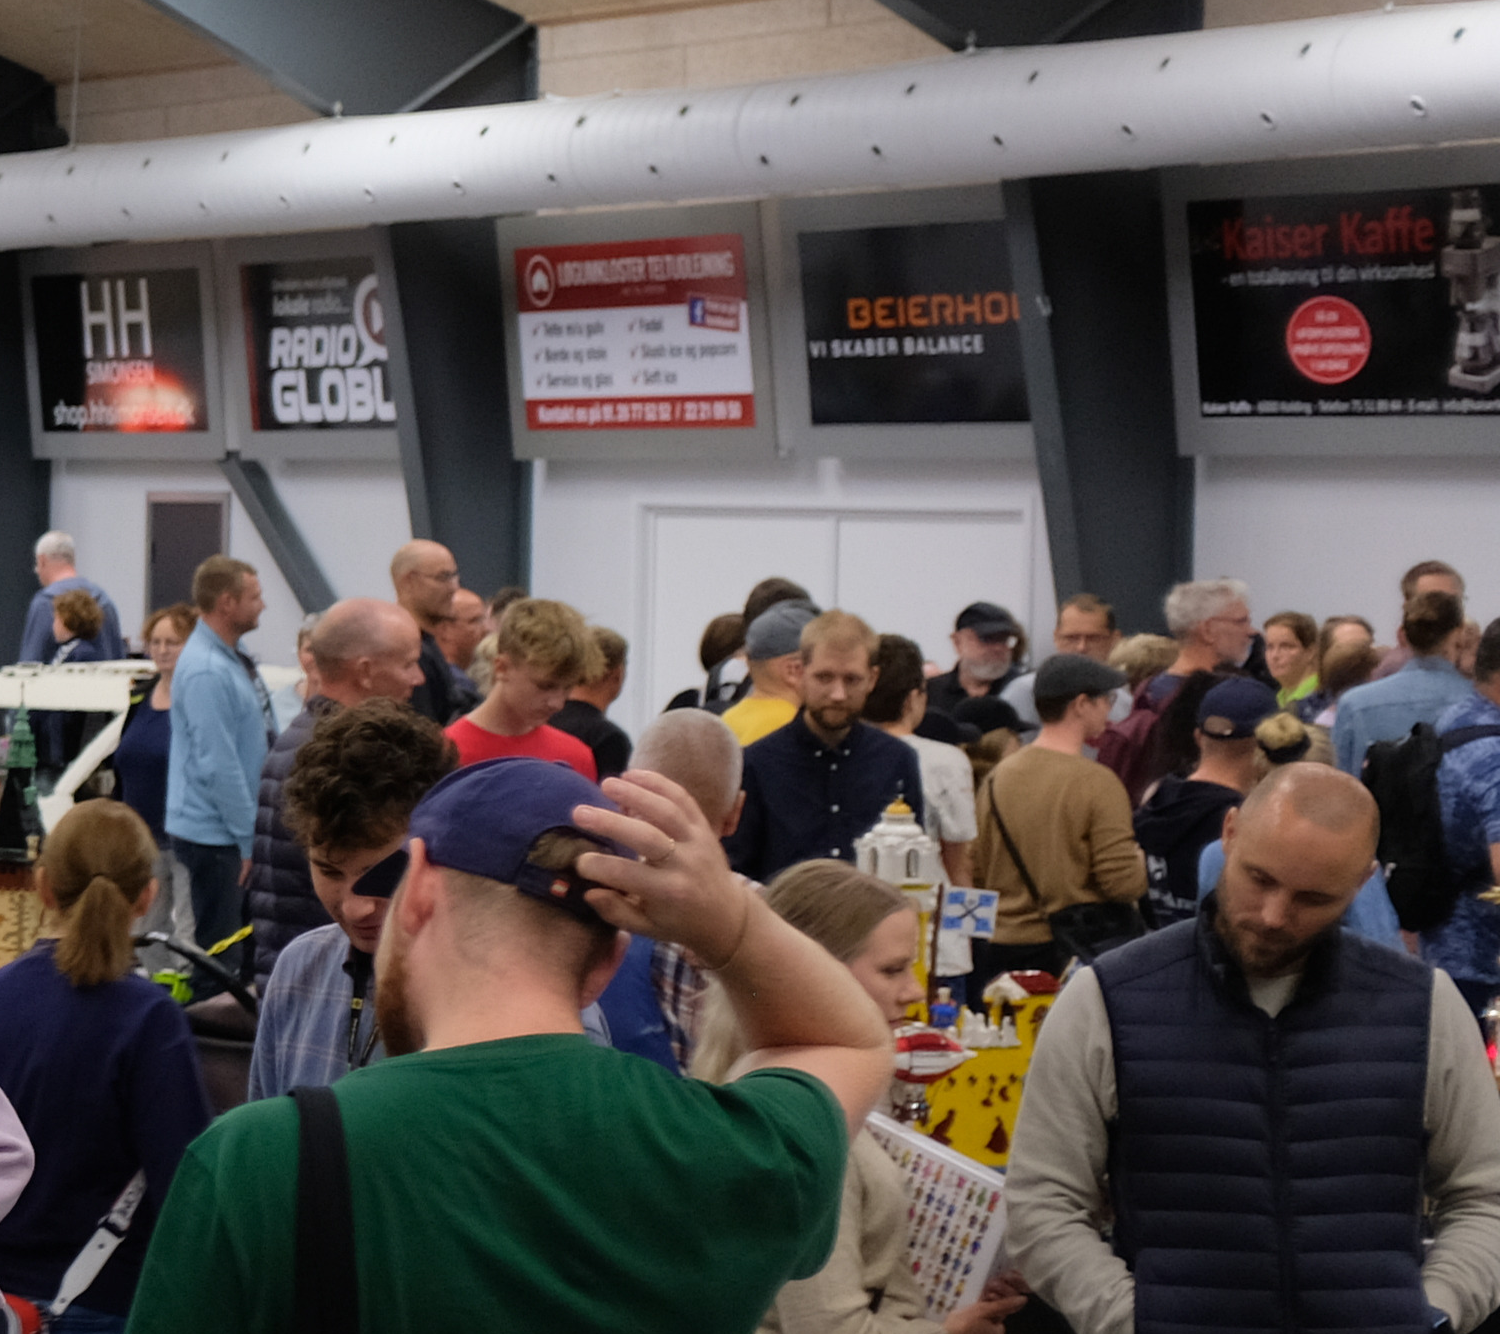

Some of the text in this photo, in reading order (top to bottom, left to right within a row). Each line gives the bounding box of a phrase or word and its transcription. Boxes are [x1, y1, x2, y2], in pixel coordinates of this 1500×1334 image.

[1221, 204, 1436, 262] Kaiser Kaffe
[79, 277, 154, 359] HH
[269, 323, 359, 369] RADIO
[808, 333, 985, 359] VI SKABER BALANCE
